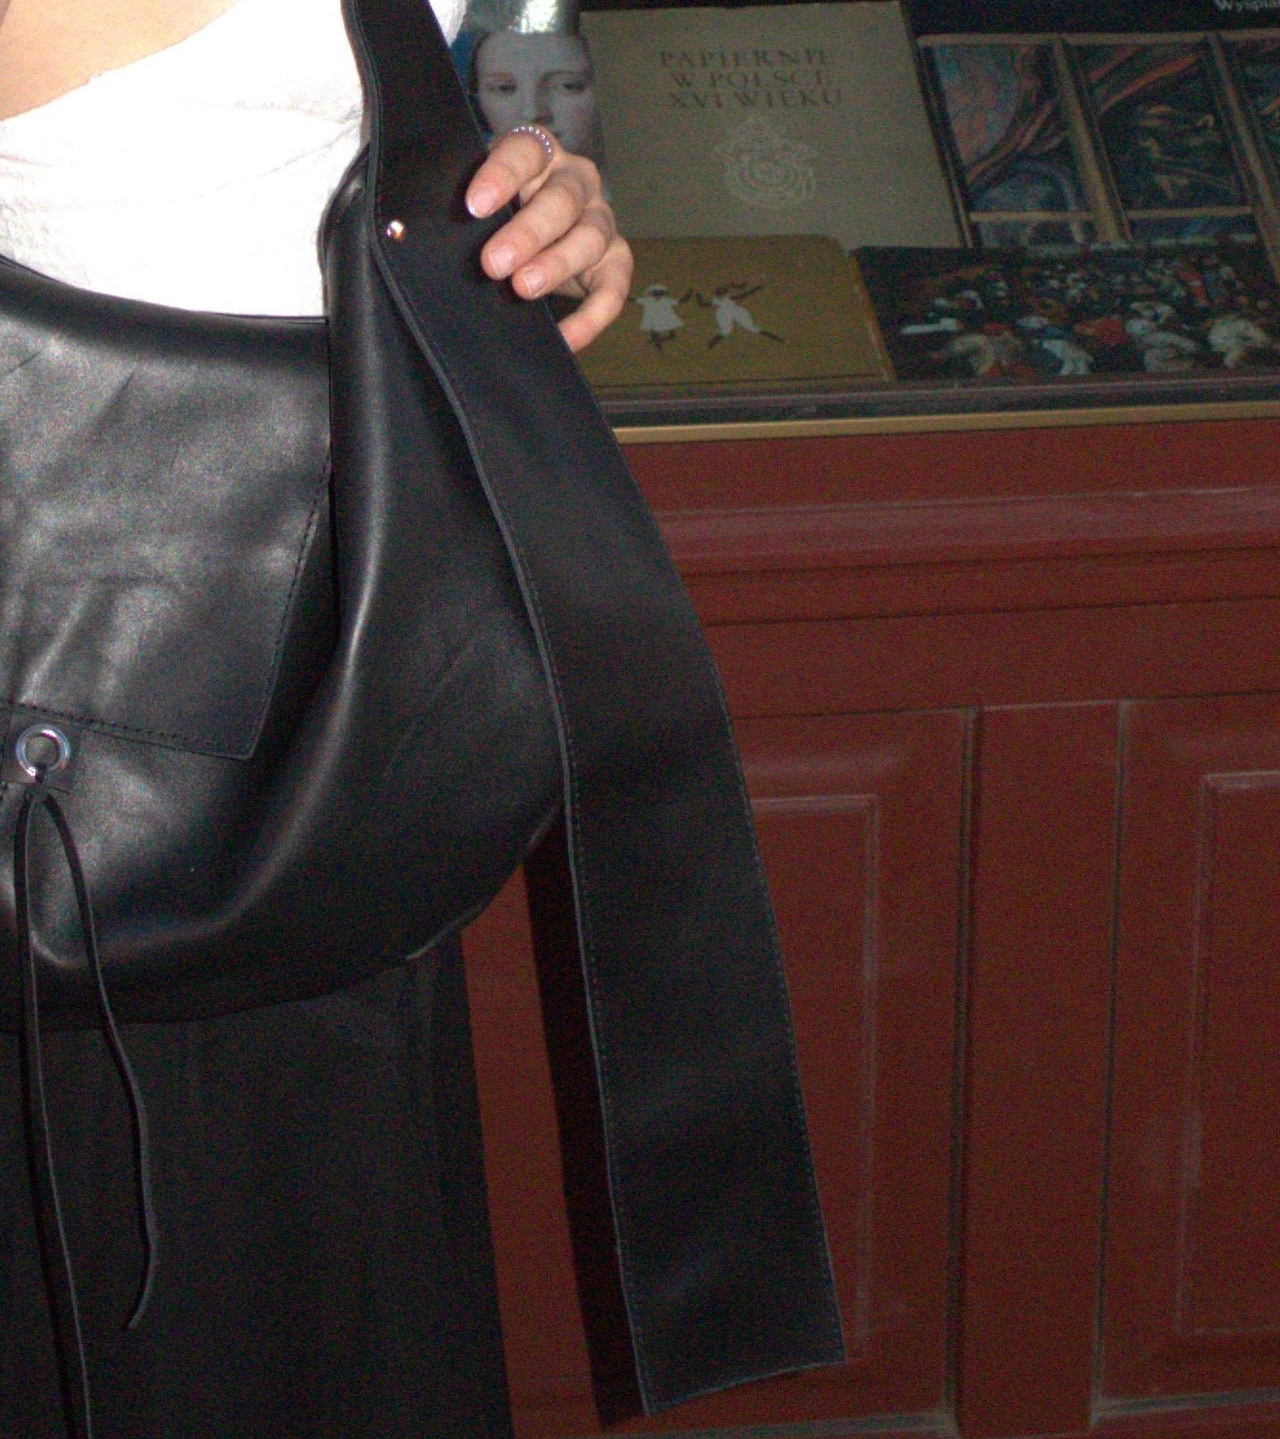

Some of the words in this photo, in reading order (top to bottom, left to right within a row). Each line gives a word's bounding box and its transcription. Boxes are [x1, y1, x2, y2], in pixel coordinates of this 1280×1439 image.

[658, 47, 837, 69] PAPIERNIE
[670, 71, 696, 89] W
[708, 68, 835, 89] POLSCE
[669, 90, 725, 111] XVI
[732, 88, 844, 111] WIEKU
